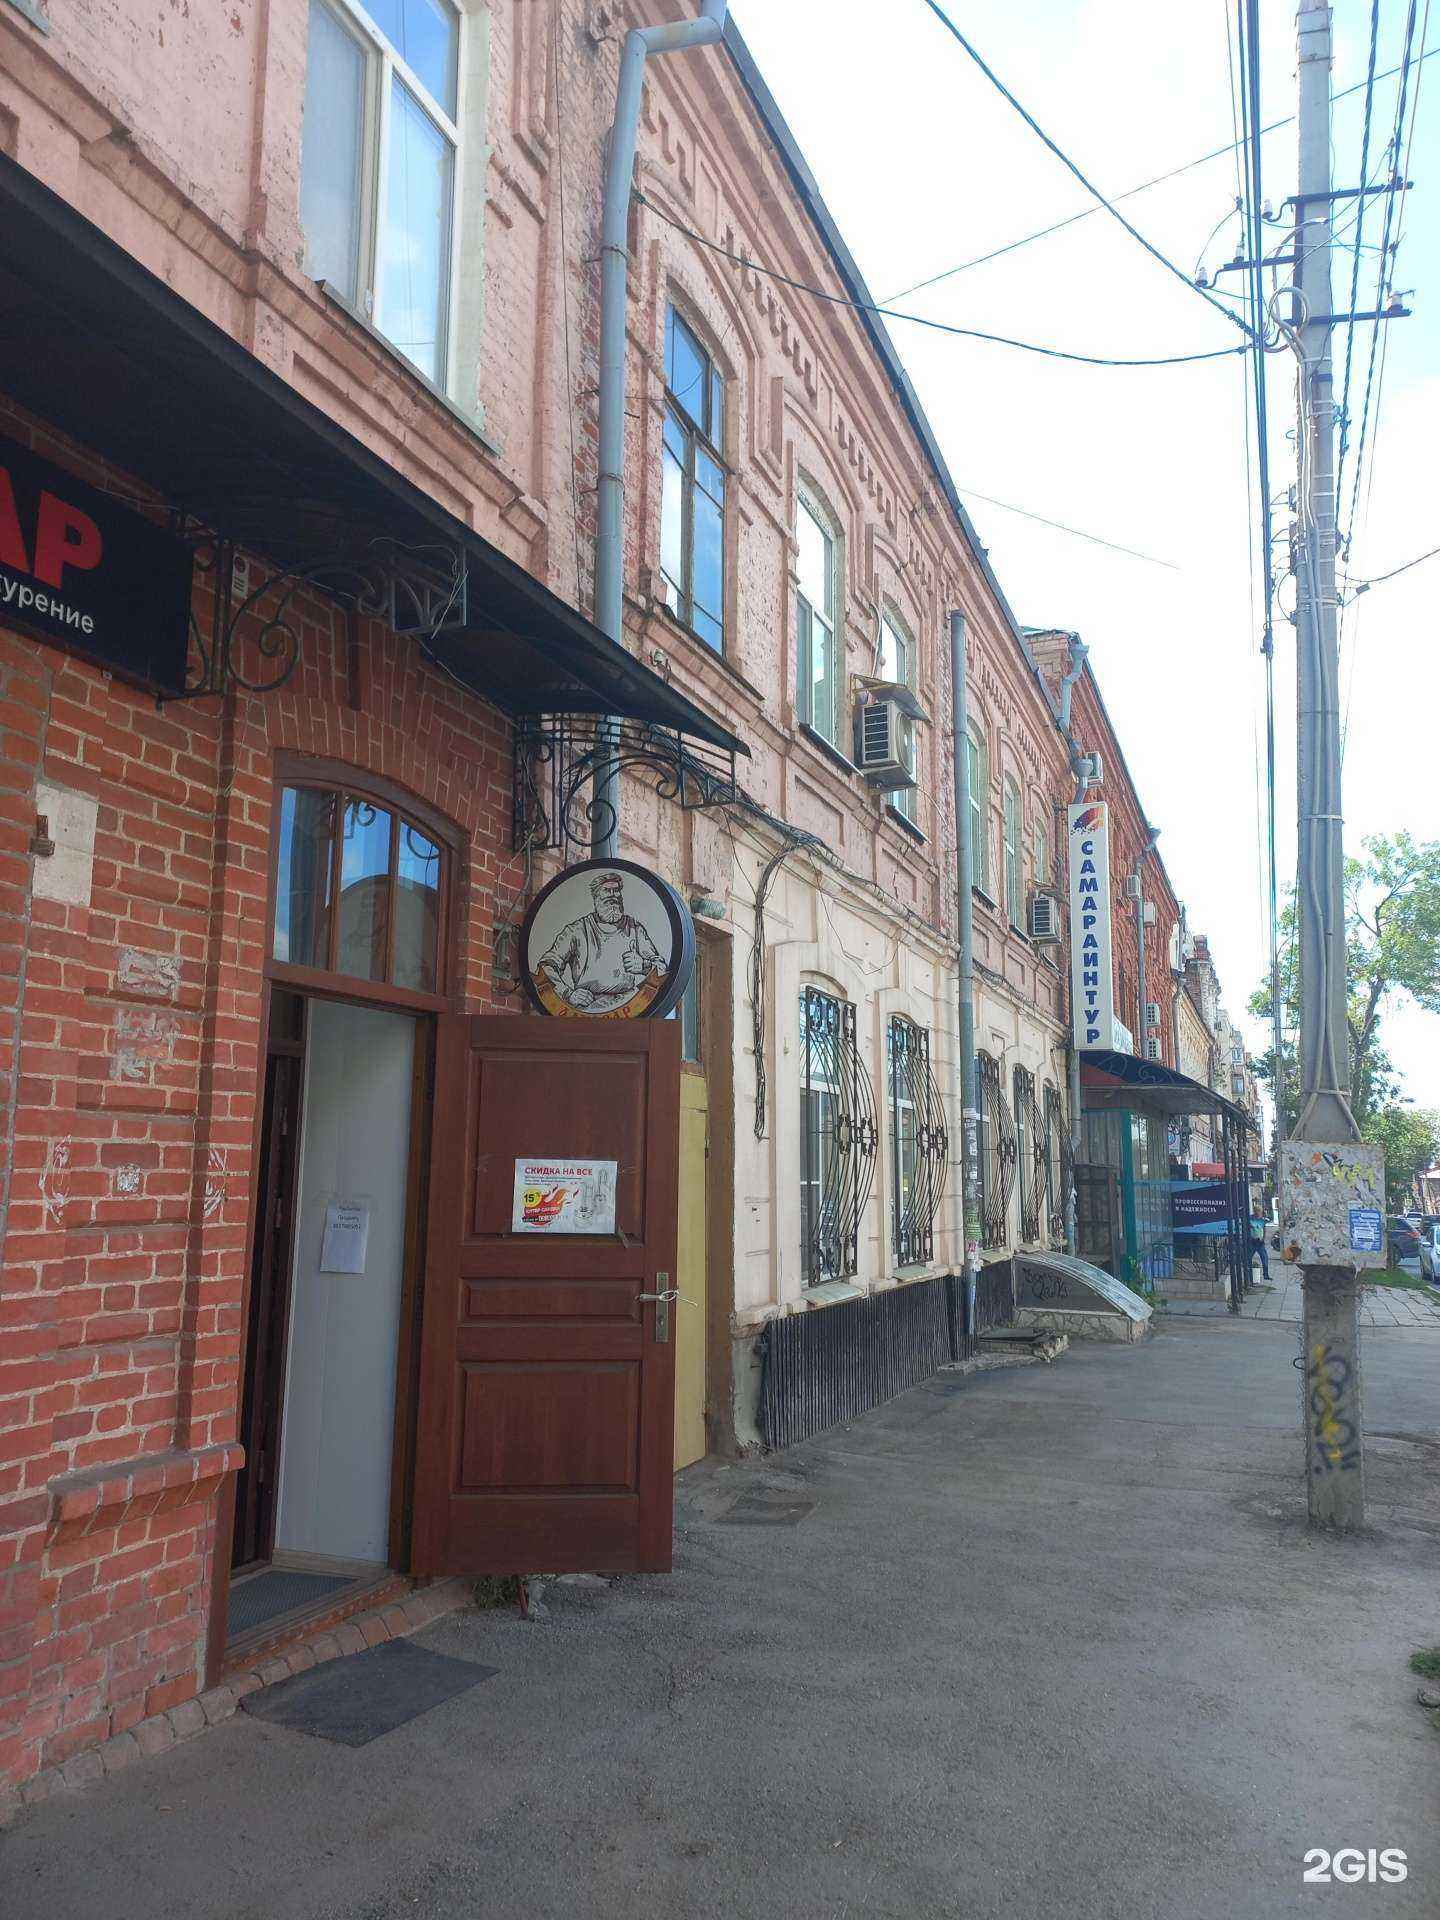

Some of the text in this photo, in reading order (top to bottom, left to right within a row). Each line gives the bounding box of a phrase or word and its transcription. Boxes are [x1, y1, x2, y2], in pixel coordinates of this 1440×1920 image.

[0, 574, 95, 634] урение
[1078, 840, 1100, 1044] САМАРАИНТУР
[524, 1167, 593, 1176] СКИДКА НА ВСЕ
[1174, 1198, 1227, 1206] ПРОФЕССИОНАЛИЗ
